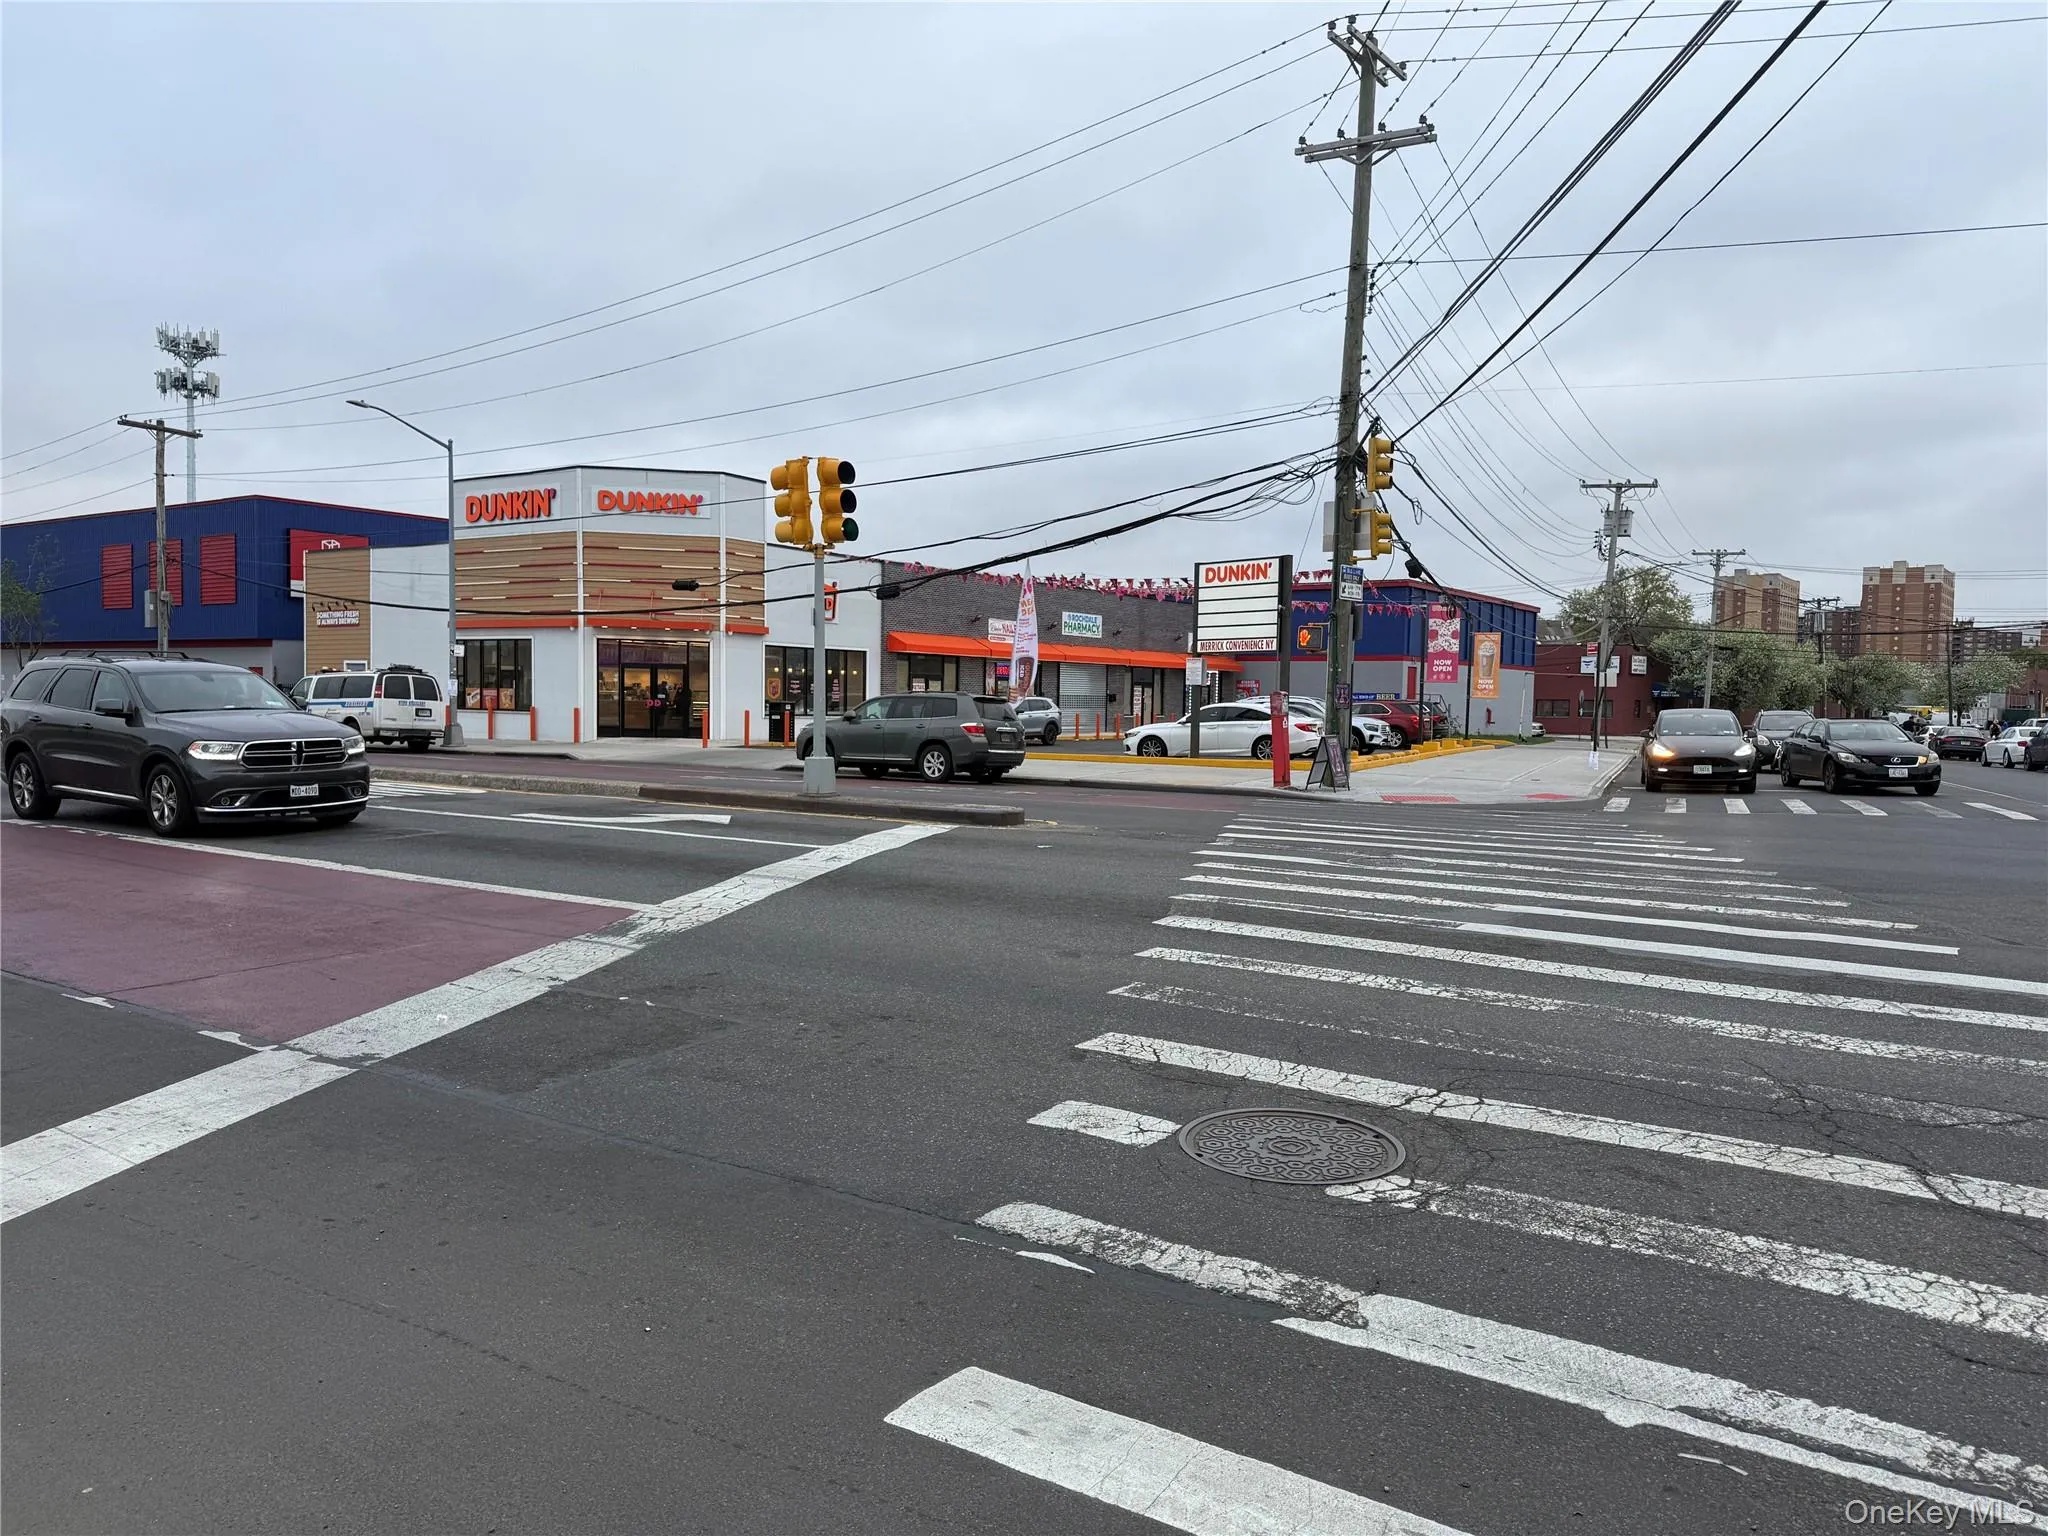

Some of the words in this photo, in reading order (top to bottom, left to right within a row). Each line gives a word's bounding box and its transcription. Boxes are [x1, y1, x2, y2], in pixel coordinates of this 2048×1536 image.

[465, 488, 557, 523] DUNKIN'
[597, 489, 704, 516] DUNKIN'
[1204, 562, 1272, 584] DUNKIN'
[1063, 621, 1101, 634] PHARMACY
[1200, 641, 1224, 651] MERRICK
[1225, 640, 1264, 651] CONVENIENCE
[1265, 639, 1275, 649] NY
